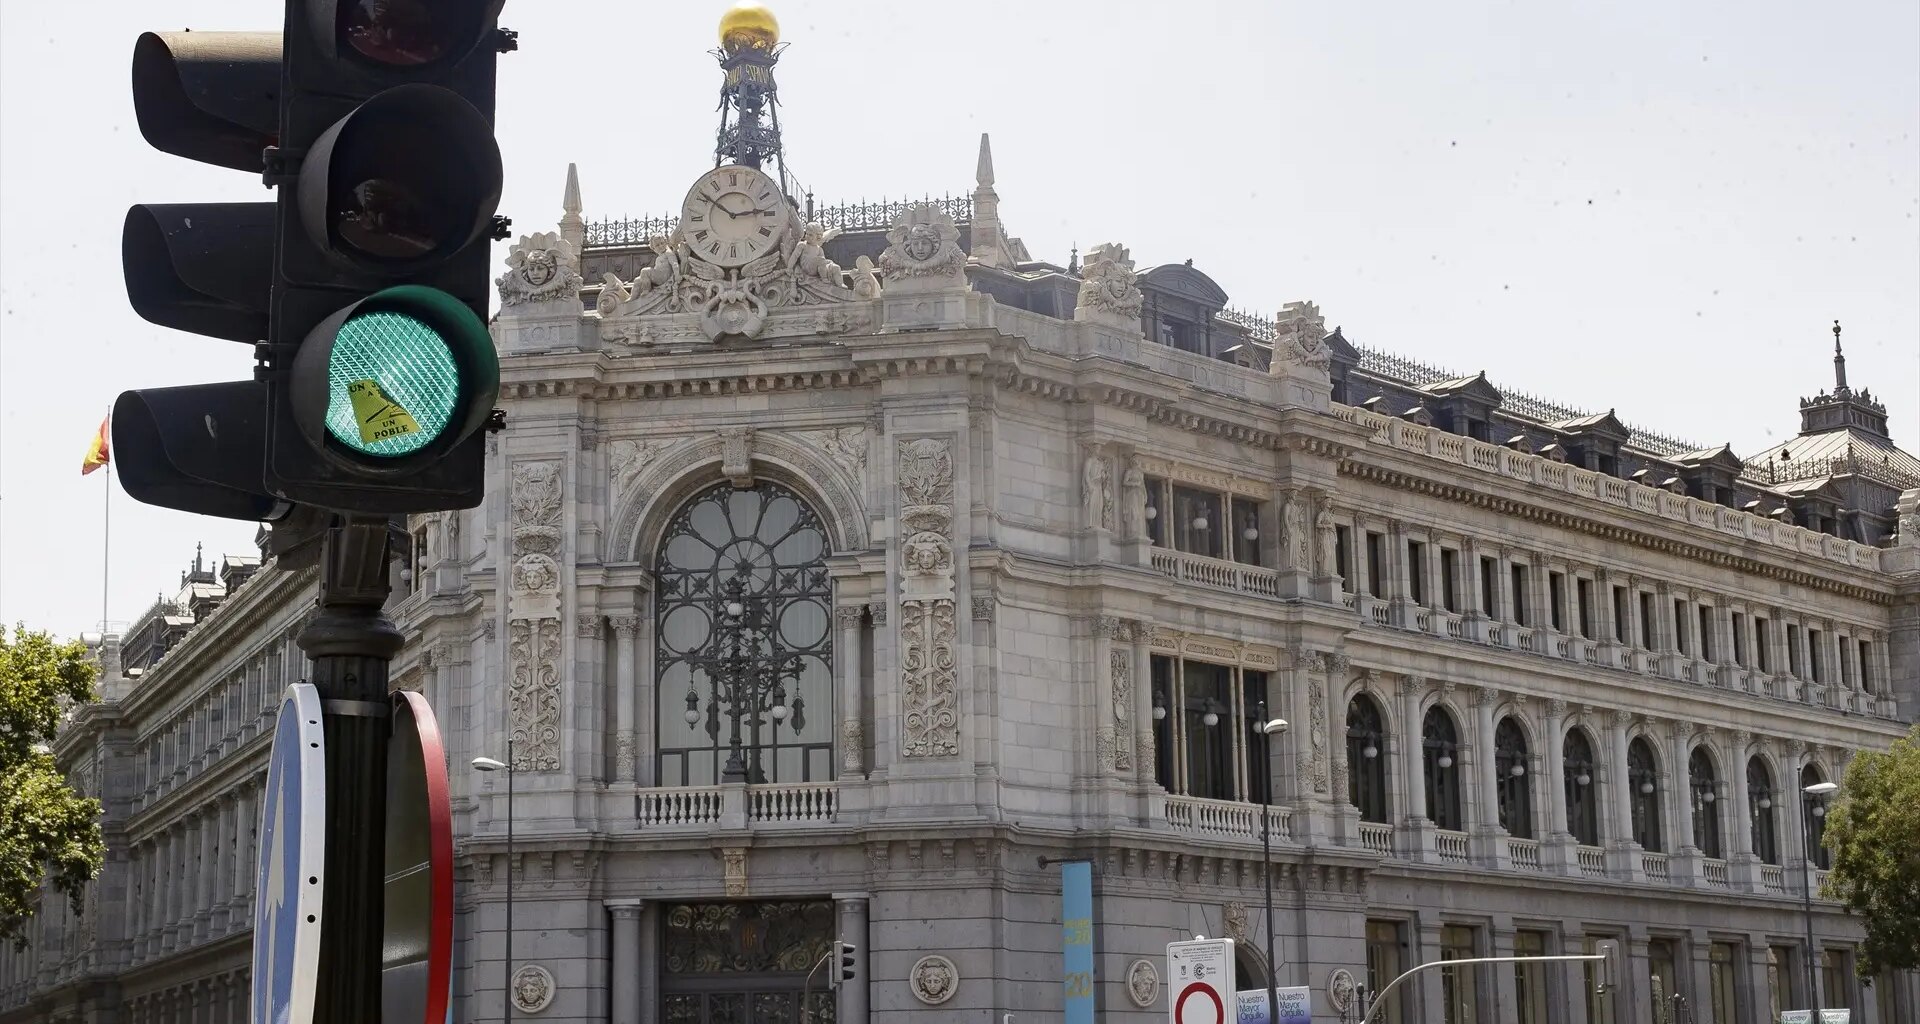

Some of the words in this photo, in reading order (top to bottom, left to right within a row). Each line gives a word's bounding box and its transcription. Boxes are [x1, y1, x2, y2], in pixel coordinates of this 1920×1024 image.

[349, 383, 365, 393] UN
[382, 419, 396, 428] UN
[374, 424, 409, 439] POBLE
[1279, 992, 1304, 1001] Nuestro
[1240, 1004, 1260, 1013] Mayor
[1280, 1001, 1300, 1010] Mayor
[1241, 1012, 1264, 1022] Orgullo
[1281, 1009, 1304, 1019] Orgullo
